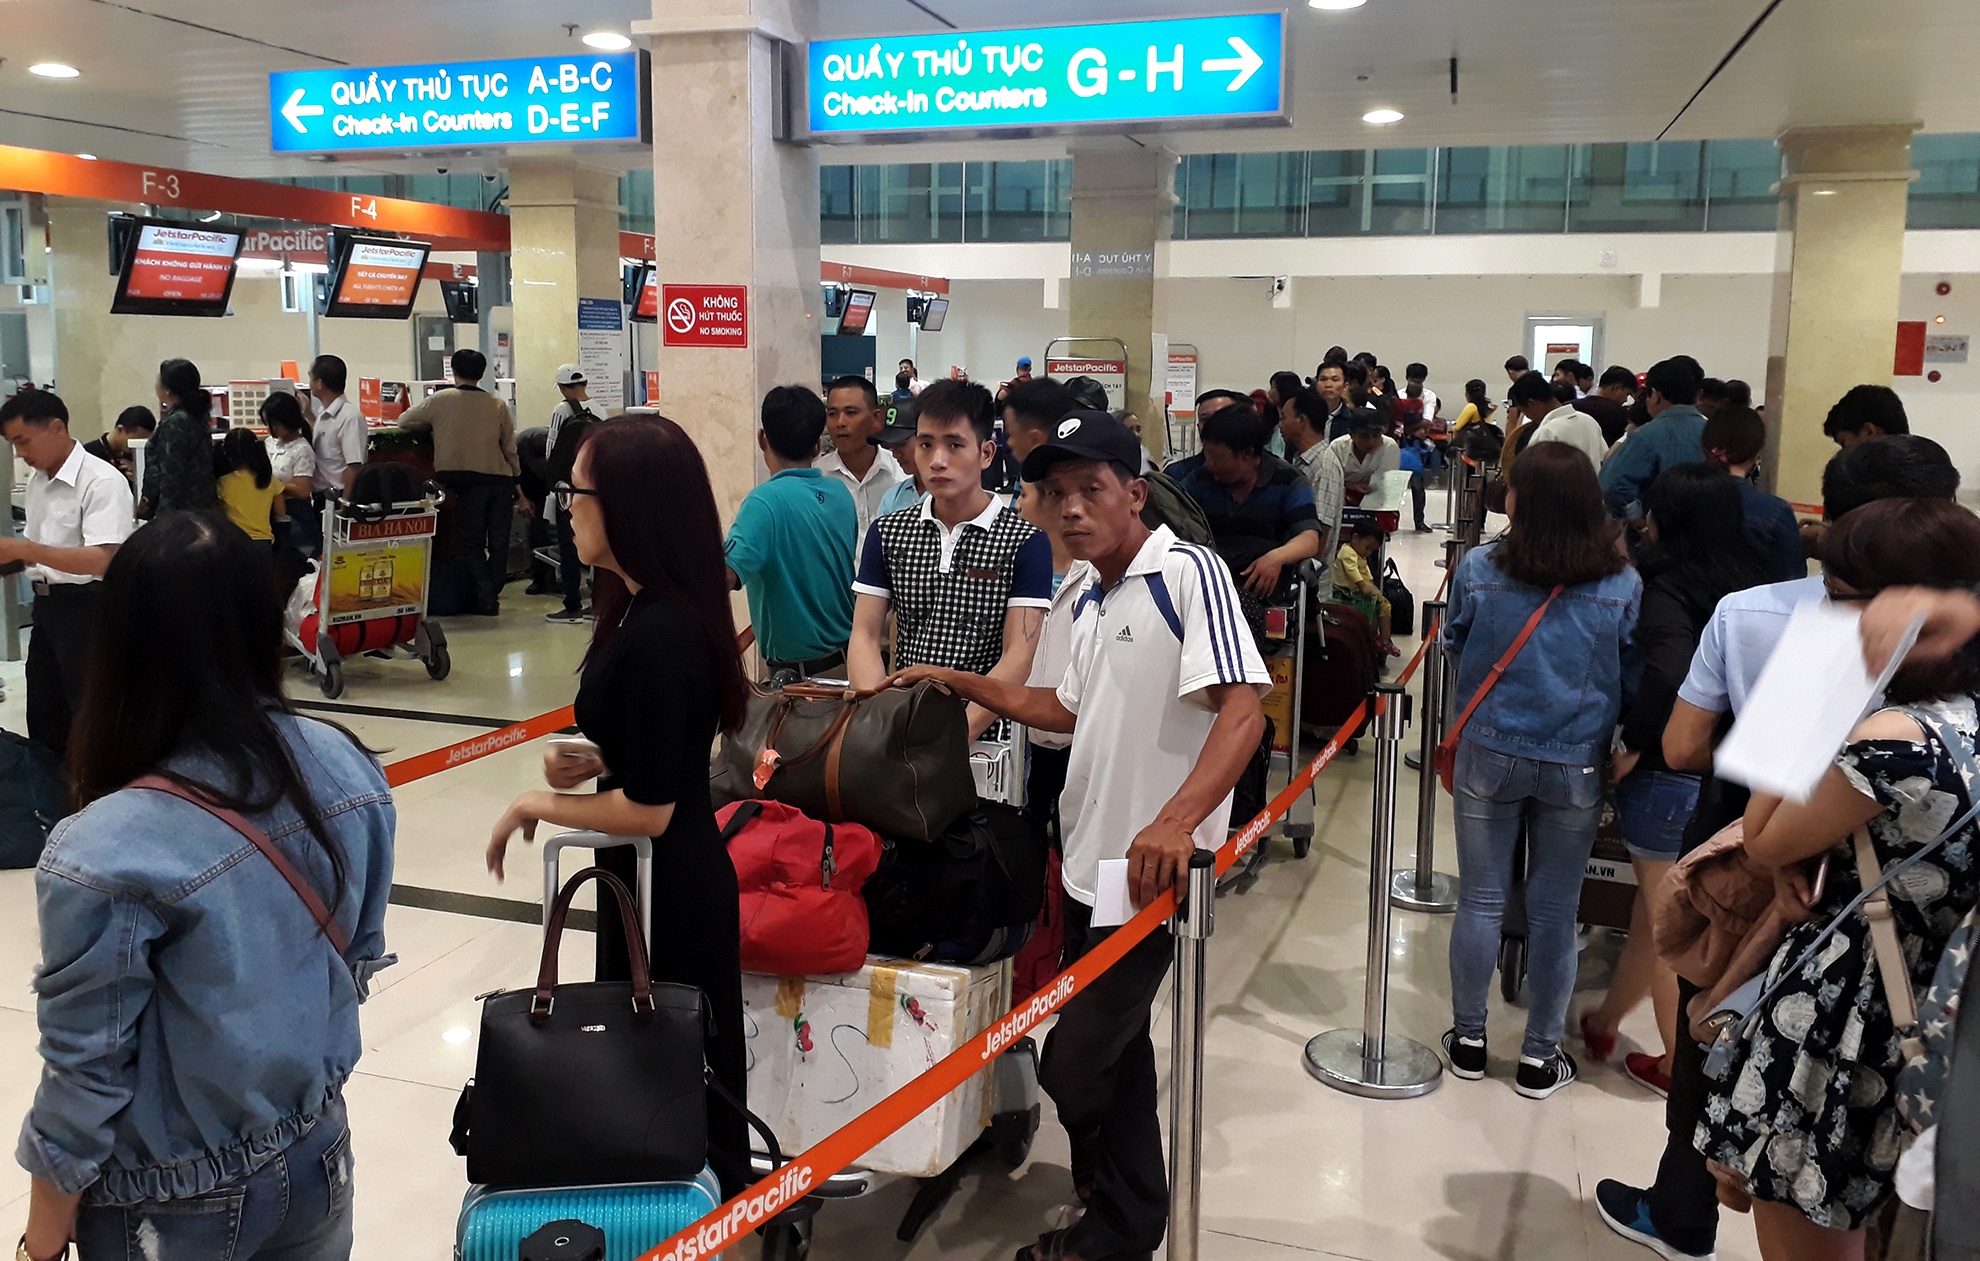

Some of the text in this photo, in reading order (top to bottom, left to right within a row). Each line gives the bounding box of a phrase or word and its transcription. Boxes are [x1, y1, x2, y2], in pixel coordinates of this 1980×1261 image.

[912, 39, 973, 77] THỦ
[981, 43, 1044, 78] TỤC
[403, 68, 451, 101] THỦ
[458, 72, 508, 102] TỤC
[528, 61, 613, 94] A-B-C
[823, 85, 1048, 117] Check-In Counters
[333, 109, 513, 137] Check-In Counters
[528, 102, 611, 134] D-E-F
[142, 171, 180, 198] F-3
[351, 196, 377, 220] F-4
[153, 229, 228, 243] JetstarPacific
[644, 238, 657, 254] F-
[361, 246, 416, 258] JetstarPacific
[703, 294, 738, 308] KHÔNG
[698, 309, 743, 321] HÚT THUỐC
[699, 327, 743, 336] NO SMOKING
[1054, 363, 1117, 372] JetstarPacific
[886, 407, 897, 426] 9
[358, 525, 380, 537] BIA
[1115, 634, 1133, 643] adidas
[445, 728, 527, 765] JetstarPacific
[1234, 809, 1271, 855] JetstarPacific
[981, 975, 1075, 1060] JetstarPacific
